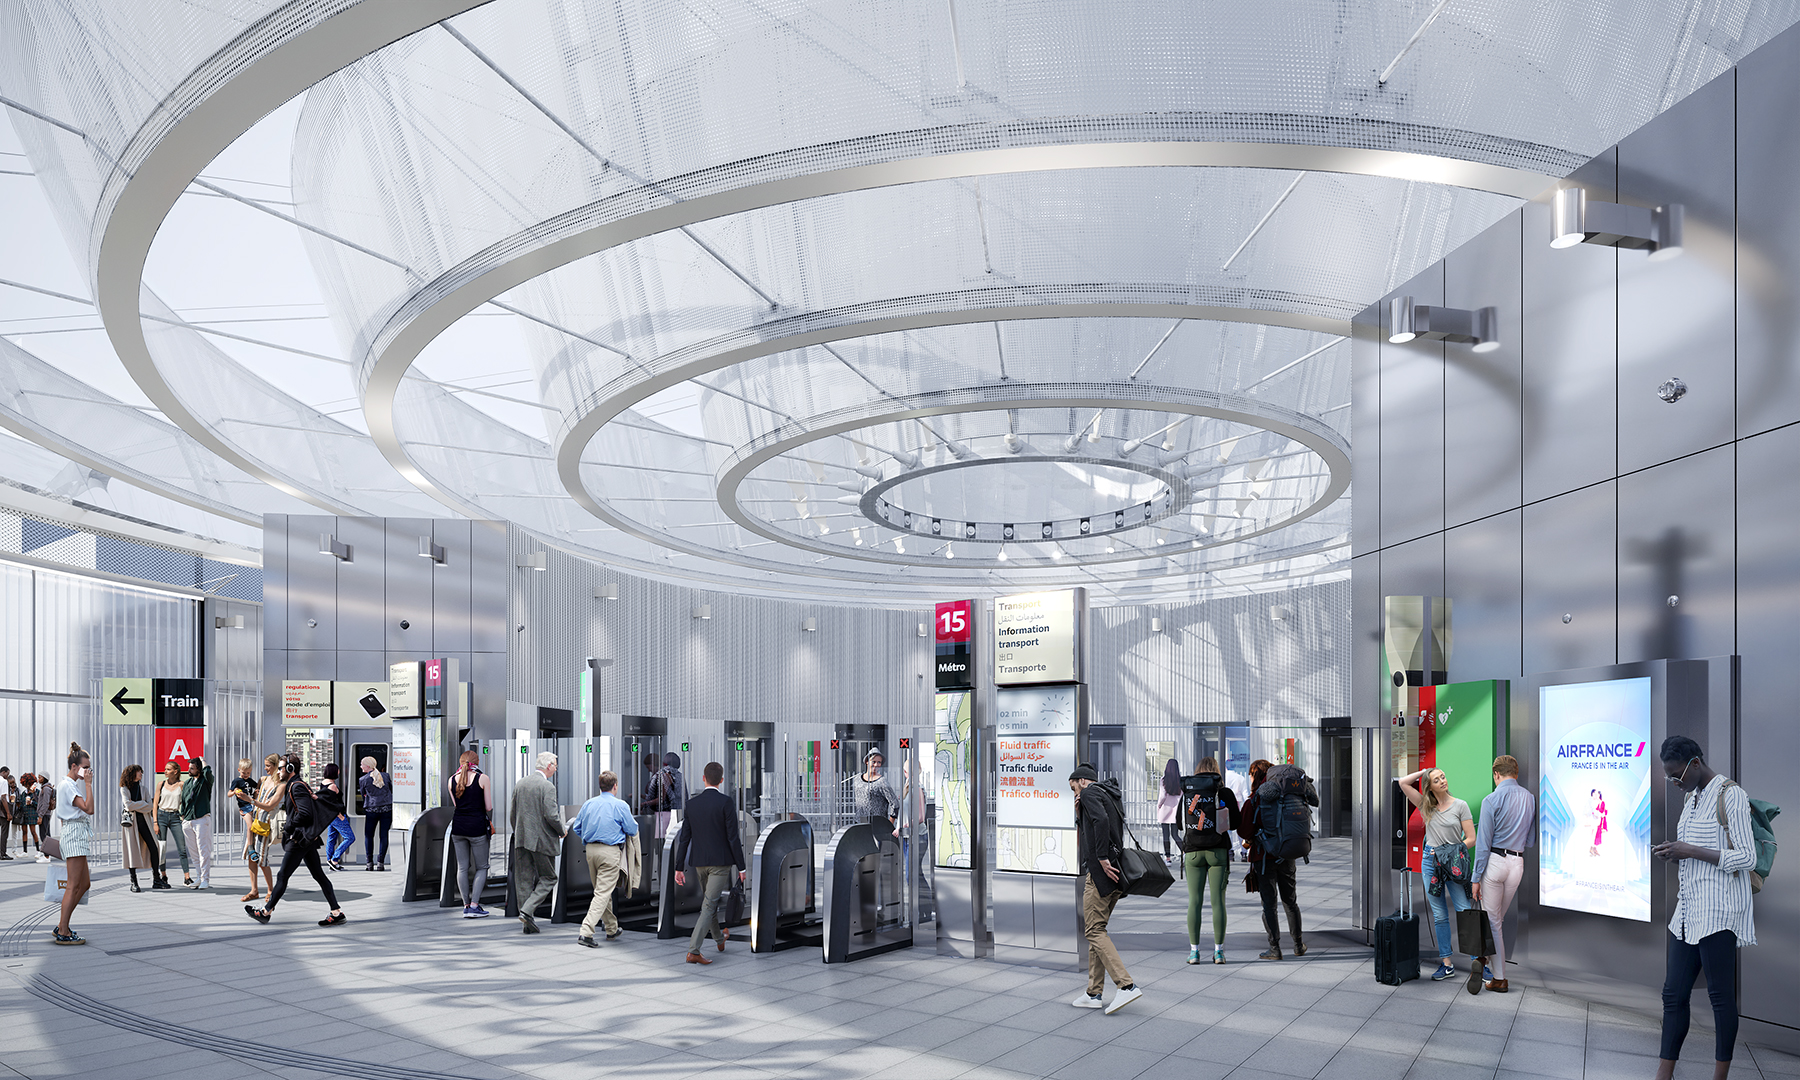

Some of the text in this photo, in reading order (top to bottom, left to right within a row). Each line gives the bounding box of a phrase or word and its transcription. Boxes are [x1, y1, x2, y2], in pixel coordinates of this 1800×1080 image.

[998, 600, 1041, 611] Transport
[941, 610, 965, 632] 15
[998, 625, 1050, 636] Information
[998, 638, 1039, 648] transport
[938, 662, 966, 672] Métro
[998, 664, 1047, 674] Transporte
[427, 666, 439, 679] 15
[160, 694, 199, 707] Train
[1011, 709, 1028, 717] min
[1011, 721, 1029, 730] min
[168, 739, 191, 760] A
[1000, 740, 1051, 750] Fluid traffic
[1556, 743, 1632, 758] AIRFRANCE
[1000, 764, 1053, 773] Trafic fluide
[1571, 761, 1629, 770] FRANCE IS IN THE AIR
[1000, 789, 1060, 799] Tráfico fluido
